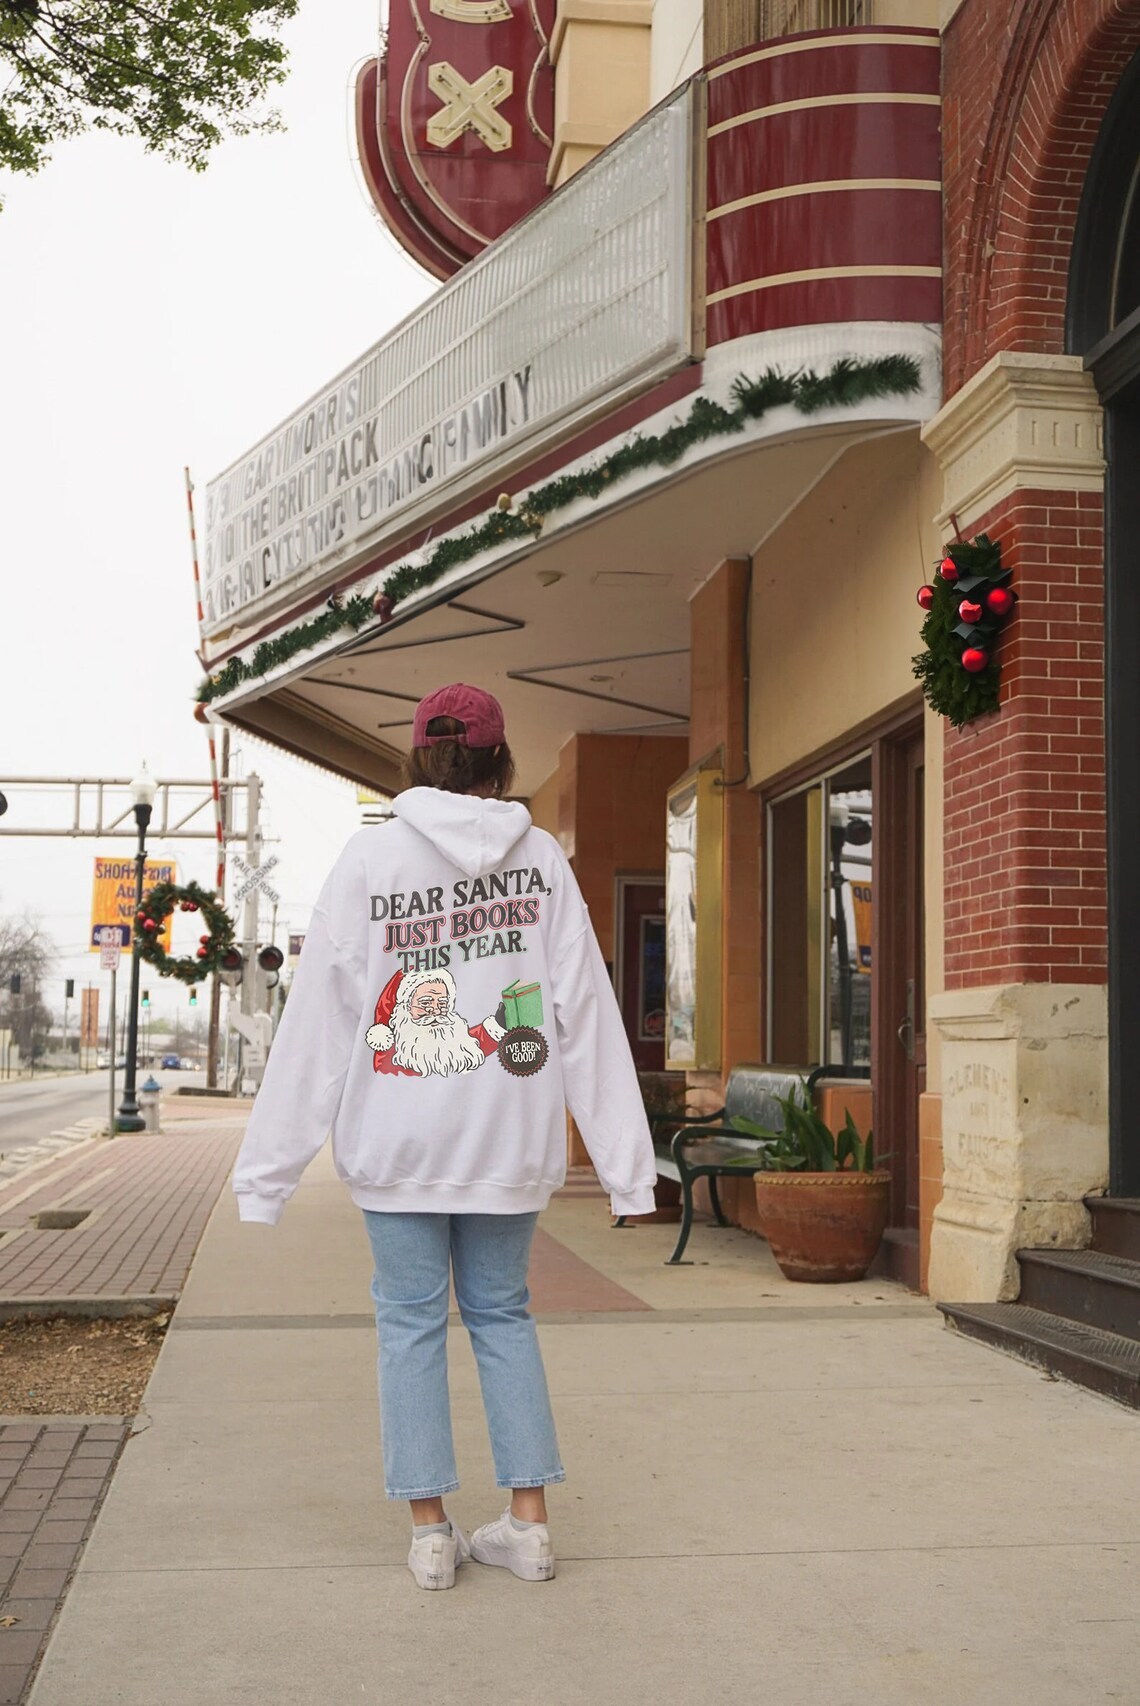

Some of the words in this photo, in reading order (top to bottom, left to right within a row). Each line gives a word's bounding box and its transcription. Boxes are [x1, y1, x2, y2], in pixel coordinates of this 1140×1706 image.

[423, 0, 514, 153] X
[244, 437, 285, 500] GARY
[292, 377, 358, 464] MORRIS
[242, 496, 269, 551] THE
[278, 462, 316, 527] BRIT
[325, 416, 379, 494] PACK
[231, 855, 251, 877] RAIL
[258, 881, 279, 902] ROAD
[370, 887, 444, 921] DEAR
[453, 867, 552, 908] SANTA,
[384, 917, 446, 952] JUST
[450, 898, 540, 940] BOOKS
[397, 945, 451, 973] THIS
[458, 930, 527, 961] YEAR.
[505, 1042, 520, 1053] I'VE
[520, 1041, 541, 1052] BEEN
[511, 1051, 536, 1063] GOOD!
